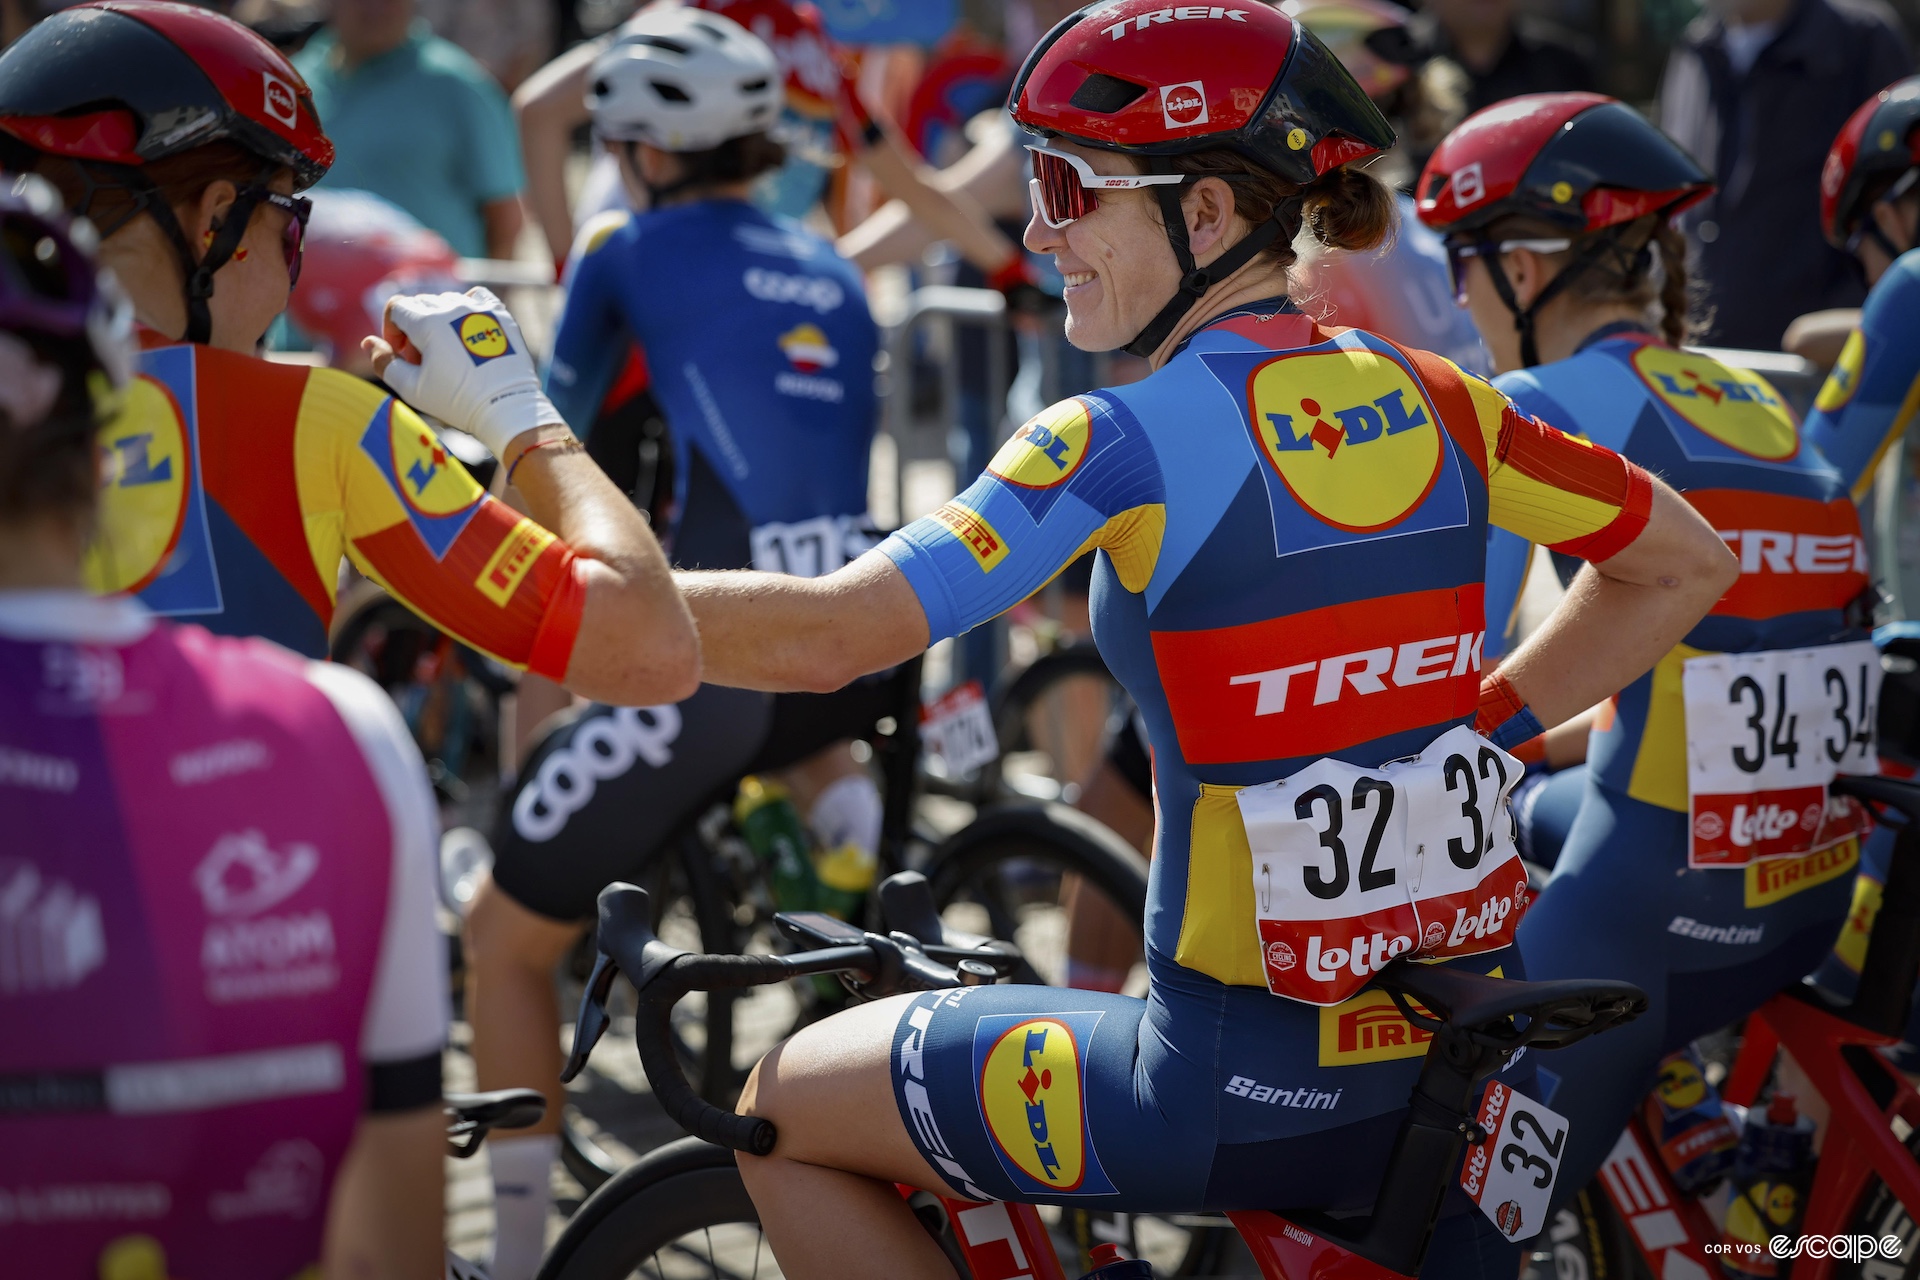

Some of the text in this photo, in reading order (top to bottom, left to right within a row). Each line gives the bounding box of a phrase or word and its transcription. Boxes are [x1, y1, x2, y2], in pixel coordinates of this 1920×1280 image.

[1101, 7, 1249, 41] TREK
[1104, 179, 1130, 187] 100%
[935, 504, 998, 559] IRELLI
[1229, 630, 1485, 717] TREK
[1729, 662, 1874, 774] 34 34
[511, 703, 683, 843] coop
[1294, 775, 1397, 901] 32
[1667, 915, 1766, 945] Santini
[1338, 1002, 1436, 1053] PIRE
[1224, 1074, 1344, 1110] Santini
[1501, 1109, 1566, 1190] 32
[1282, 1223, 1315, 1248] HANSON
